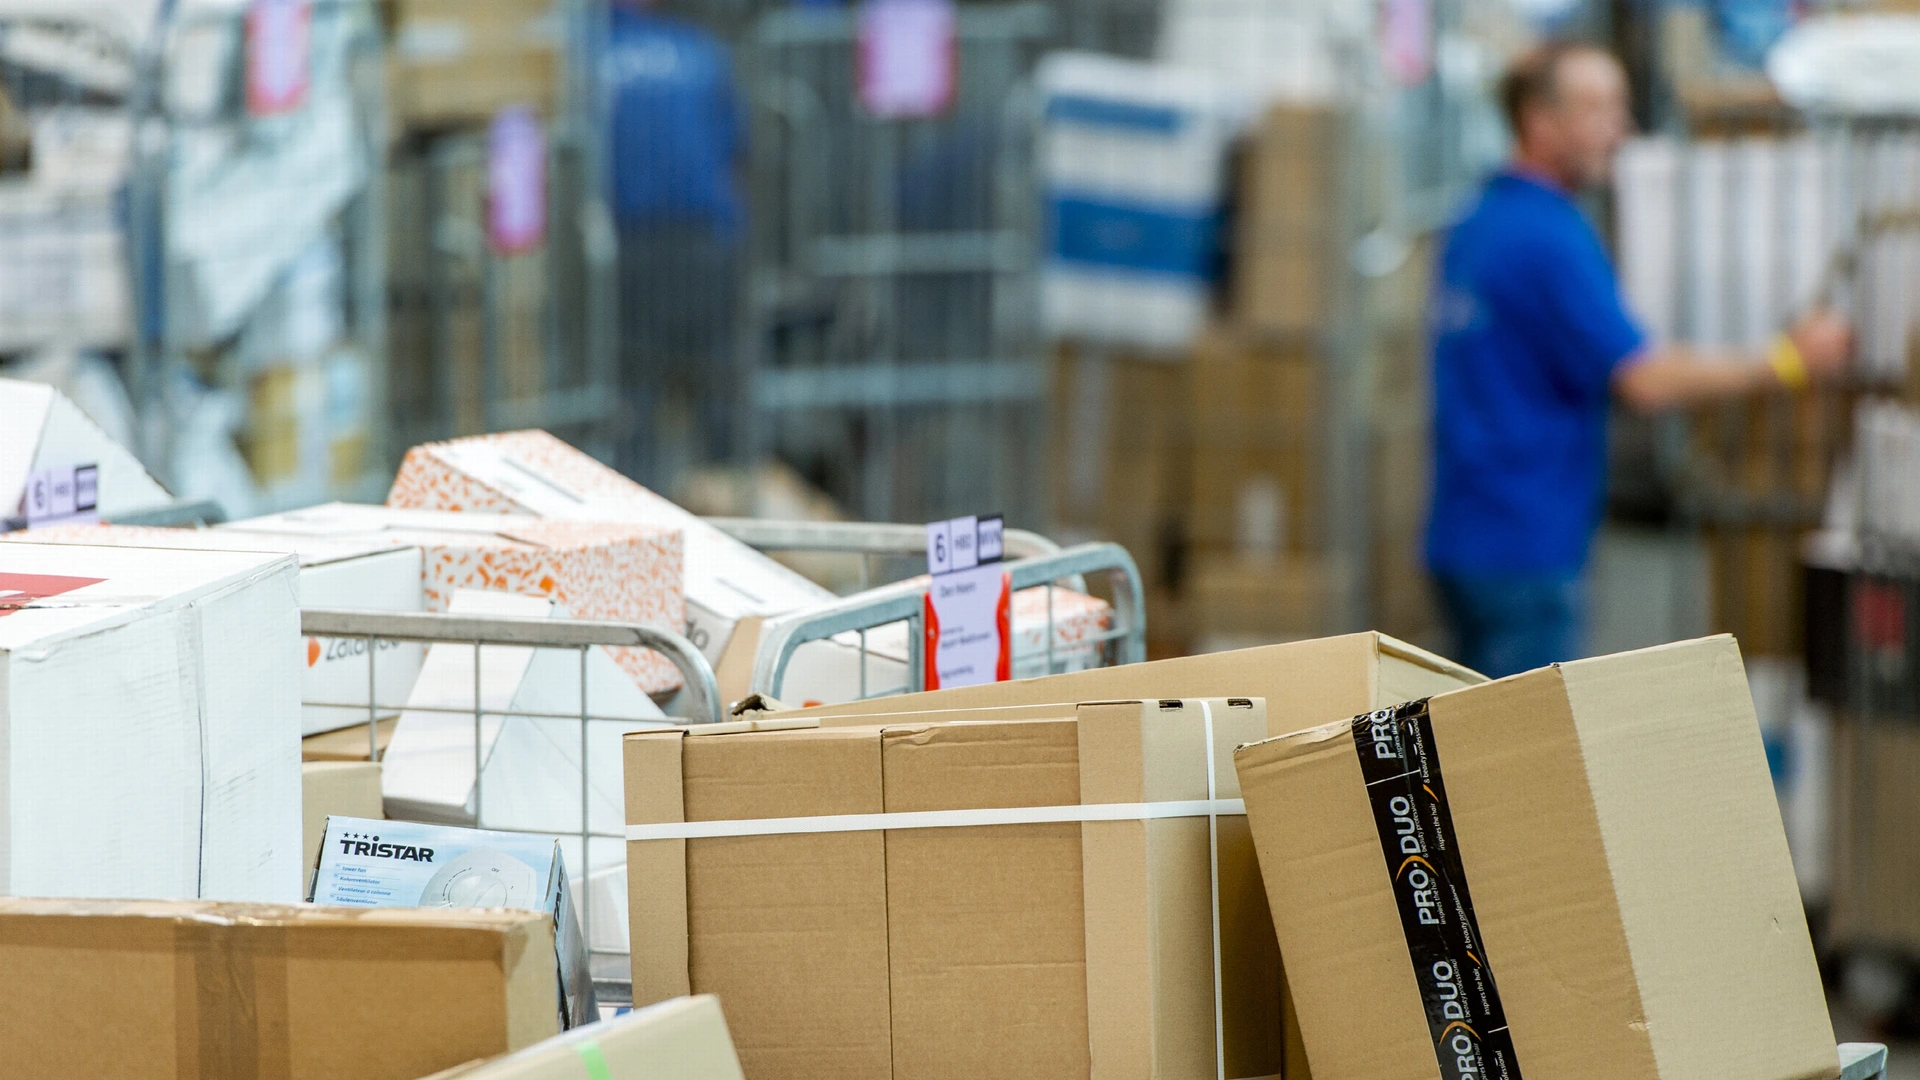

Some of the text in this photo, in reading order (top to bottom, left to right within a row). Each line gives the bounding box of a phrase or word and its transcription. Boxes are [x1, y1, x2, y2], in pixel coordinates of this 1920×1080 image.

[935, 533, 946, 563] 6
[1411, 718, 1426, 756] professional
[1420, 755, 1429, 778] beauty
[1407, 793, 1423, 831] professional
[1428, 802, 1437, 815] hair
[1431, 815, 1440, 827] the
[1418, 831, 1428, 853] beauty
[1435, 827, 1446, 851] inspires
[1429, 877, 1438, 890] hair
[1436, 901, 1447, 925] inspires
[1449, 883, 1467, 922] professional
[1461, 921, 1472, 944] beauty
[1450, 958, 1466, 996] professional
[1475, 981, 1484, 992] the
[1461, 995, 1472, 1018] beauty
[1480, 991, 1491, 1016] inspires
[1476, 1055, 1484, 1067] the
